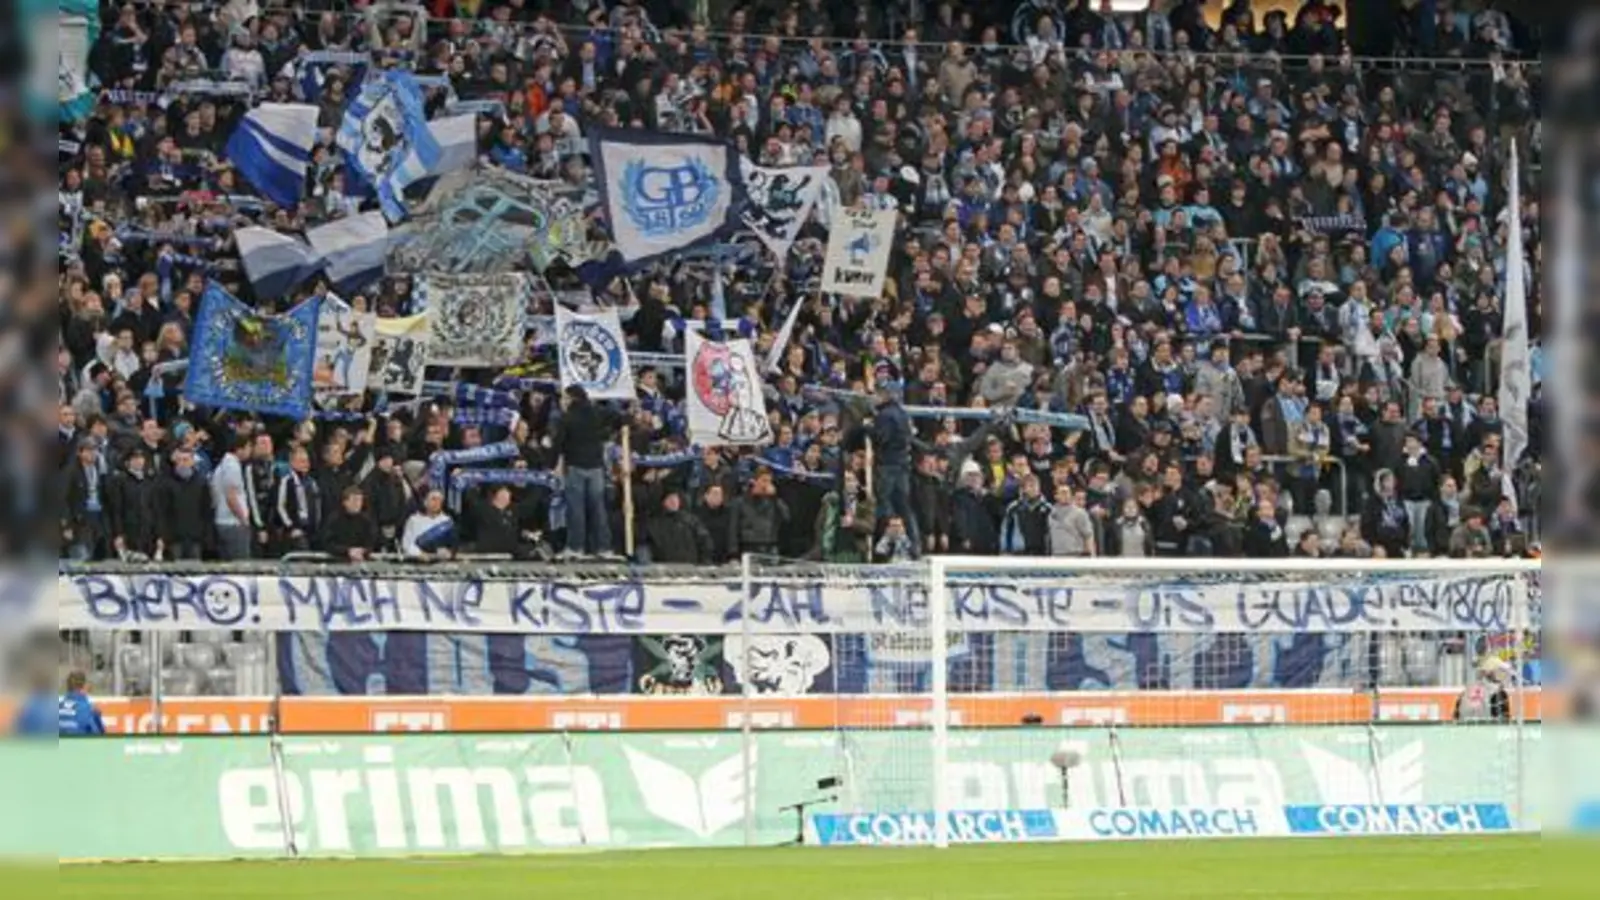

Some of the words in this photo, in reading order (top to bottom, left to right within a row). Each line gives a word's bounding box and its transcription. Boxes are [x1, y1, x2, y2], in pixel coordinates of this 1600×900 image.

[636, 167, 702, 206] GB
[218, 745, 611, 850] erima
[1089, 808, 1258, 837] COMARCH
[1317, 803, 1481, 833] COMARCH
